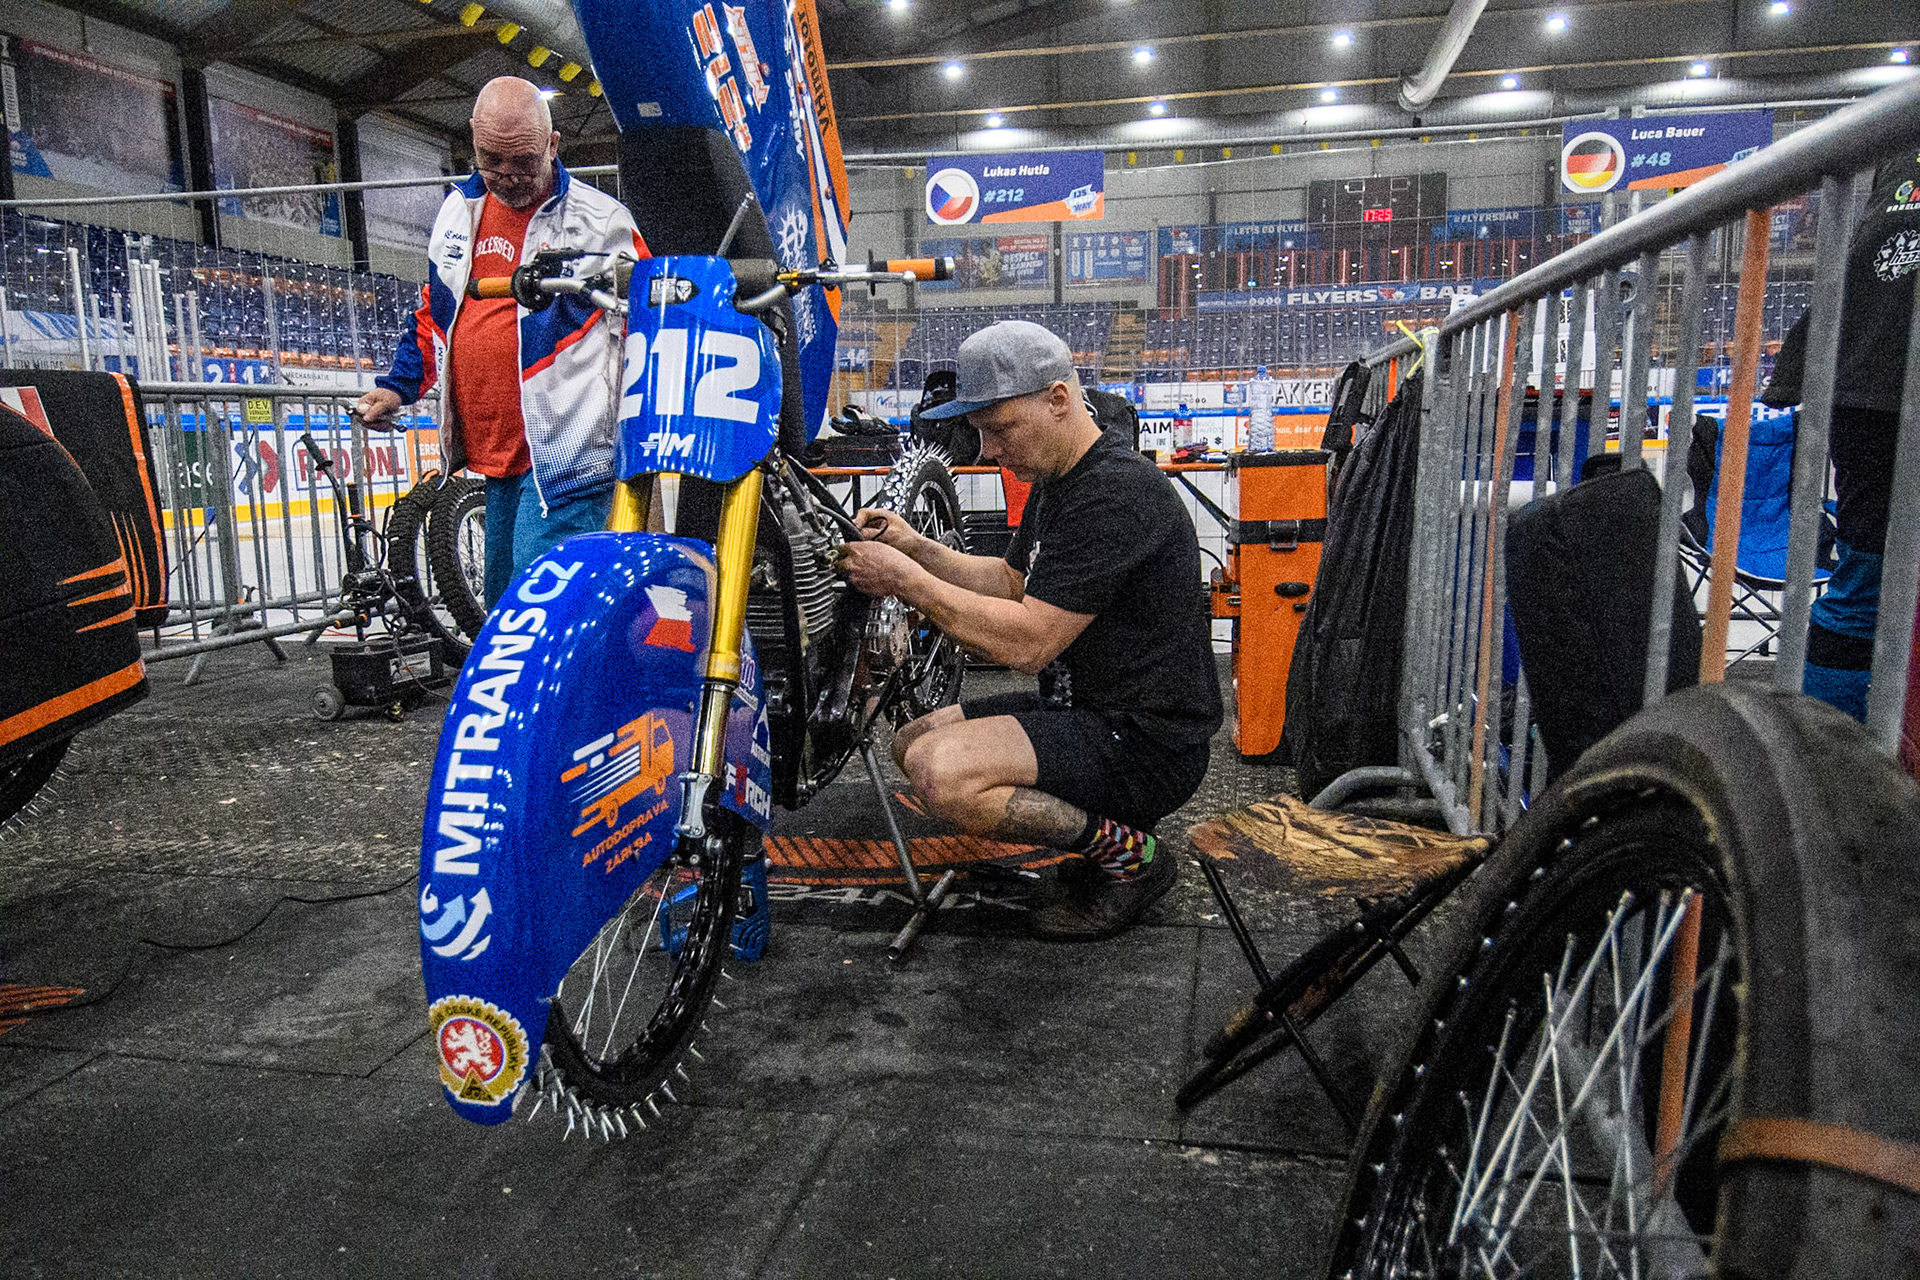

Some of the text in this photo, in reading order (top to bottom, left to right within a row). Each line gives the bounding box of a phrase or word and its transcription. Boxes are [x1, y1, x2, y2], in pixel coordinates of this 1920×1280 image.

[798, 11, 831, 136] VHmotor
[1631, 126, 1705, 140] Luca Bauer
[983, 164, 1050, 177] Lukas Hutla
[1631, 151, 1671, 168] #48
[983, 188, 1025, 202] #212
[1363, 208, 1392, 222] 17:25
[475, 235, 515, 262] BLESSED
[1287, 285, 1473, 305] FLYERS BAR
[617, 328, 761, 425] 212
[1272, 381, 1333, 405] AKKER
[640, 432, 696, 457] FIM
[433, 560, 585, 876] MITRANS CZ
[582, 799, 669, 868] AUTODOPRAVA
